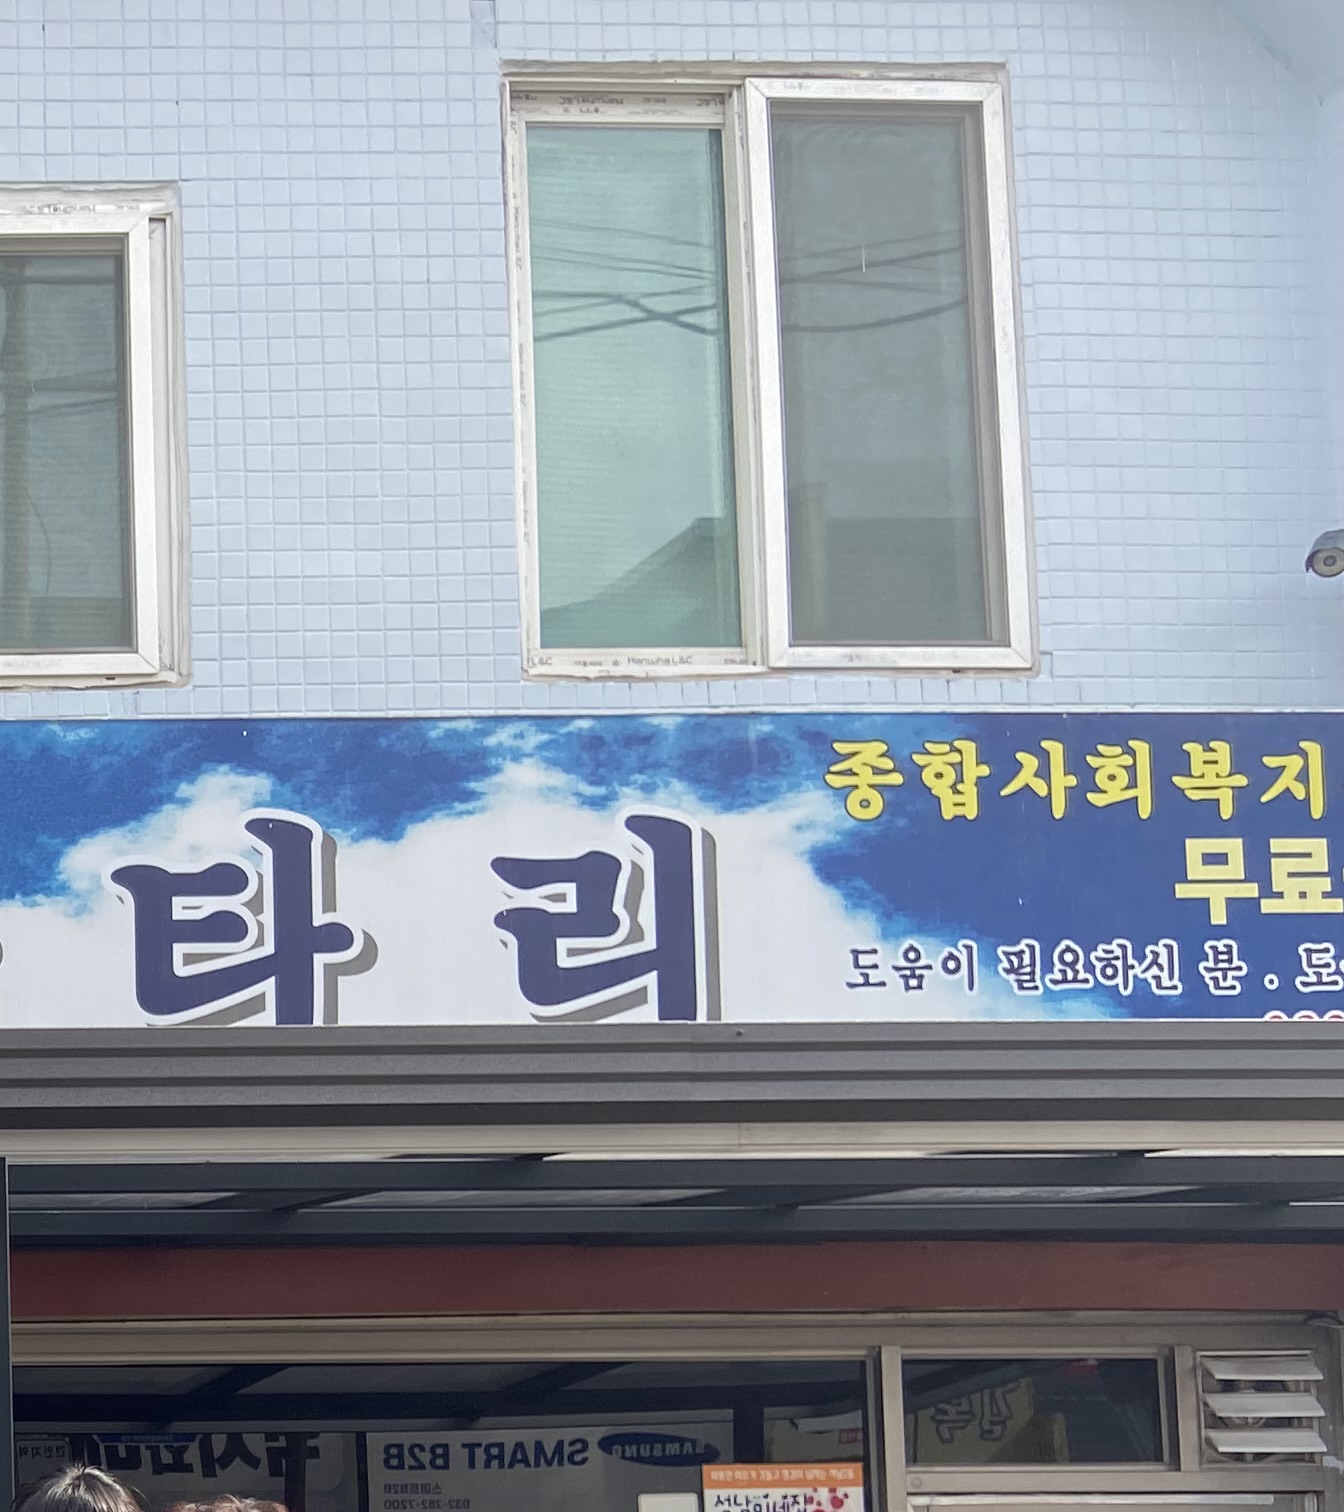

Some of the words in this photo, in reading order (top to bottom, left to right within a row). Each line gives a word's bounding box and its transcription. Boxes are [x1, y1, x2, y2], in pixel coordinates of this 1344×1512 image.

[845, 943, 977, 992] 도움이
[1000, 940, 1181, 995] 필요하신
[1198, 939, 1248, 996] 분
